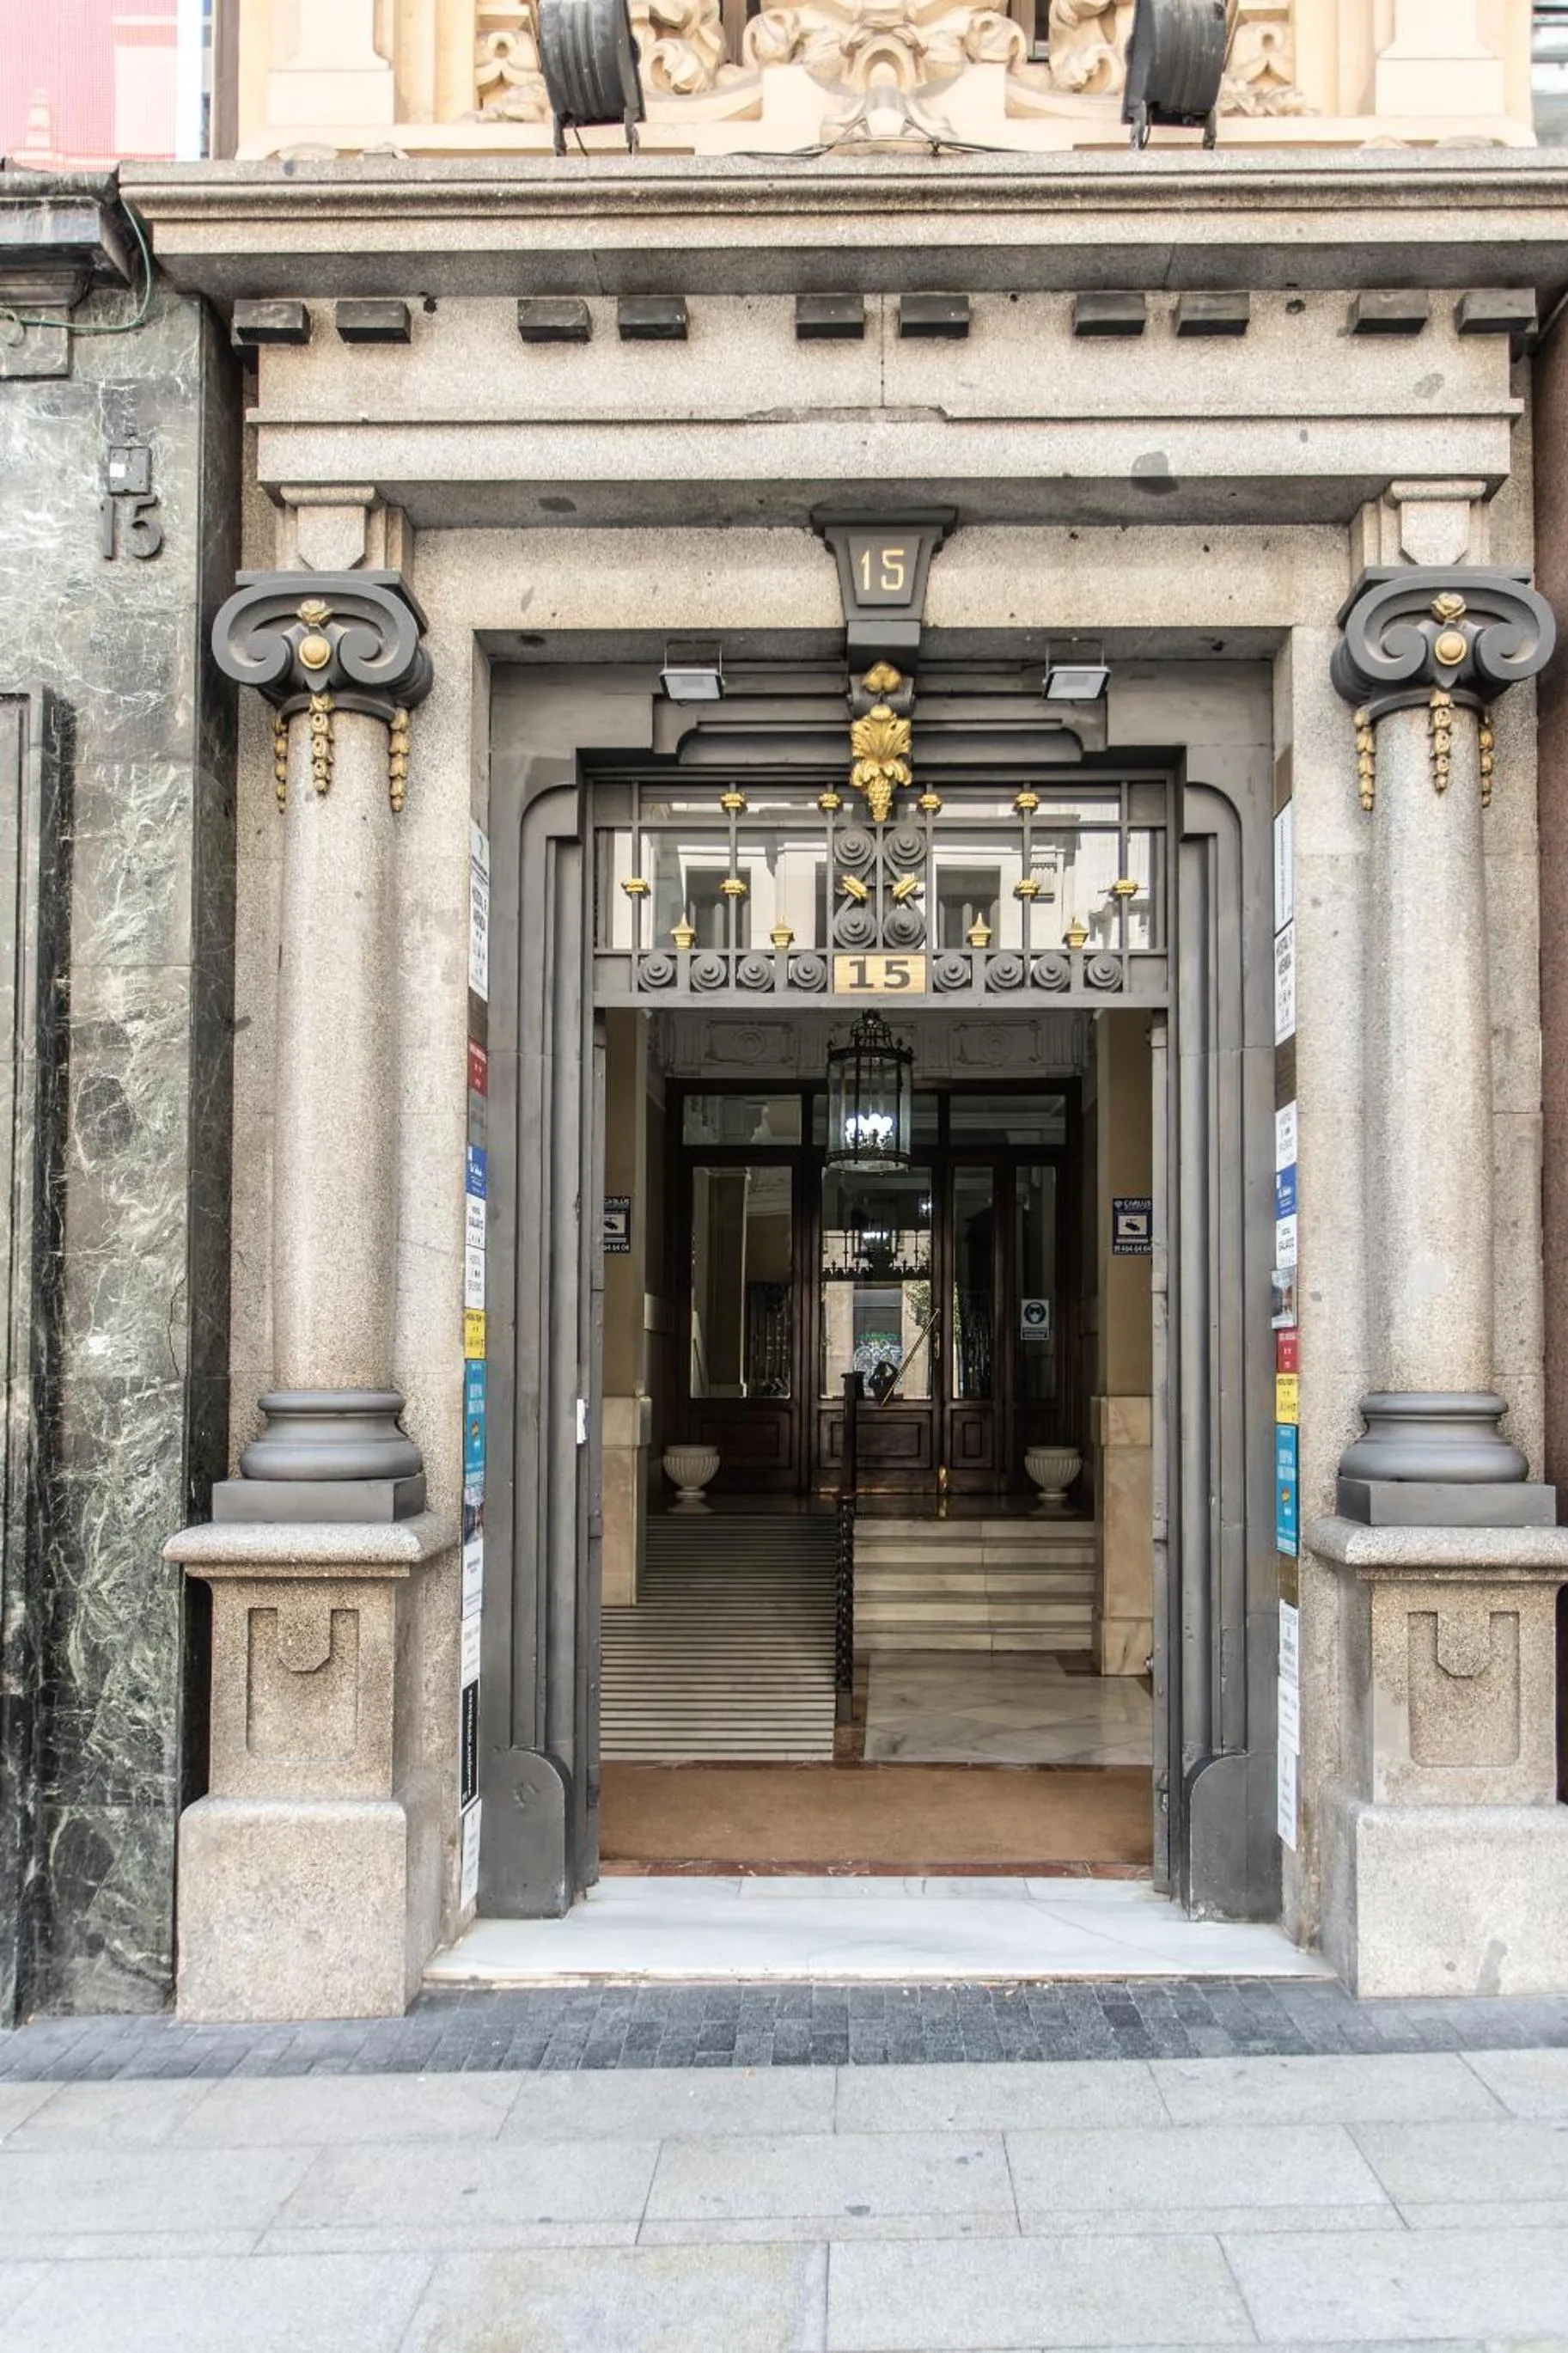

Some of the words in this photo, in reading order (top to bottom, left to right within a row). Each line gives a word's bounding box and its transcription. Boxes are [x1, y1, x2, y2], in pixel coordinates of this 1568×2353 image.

[101, 494, 164, 561] 15
[860, 549, 905, 591] 15
[849, 959, 911, 989] 15
